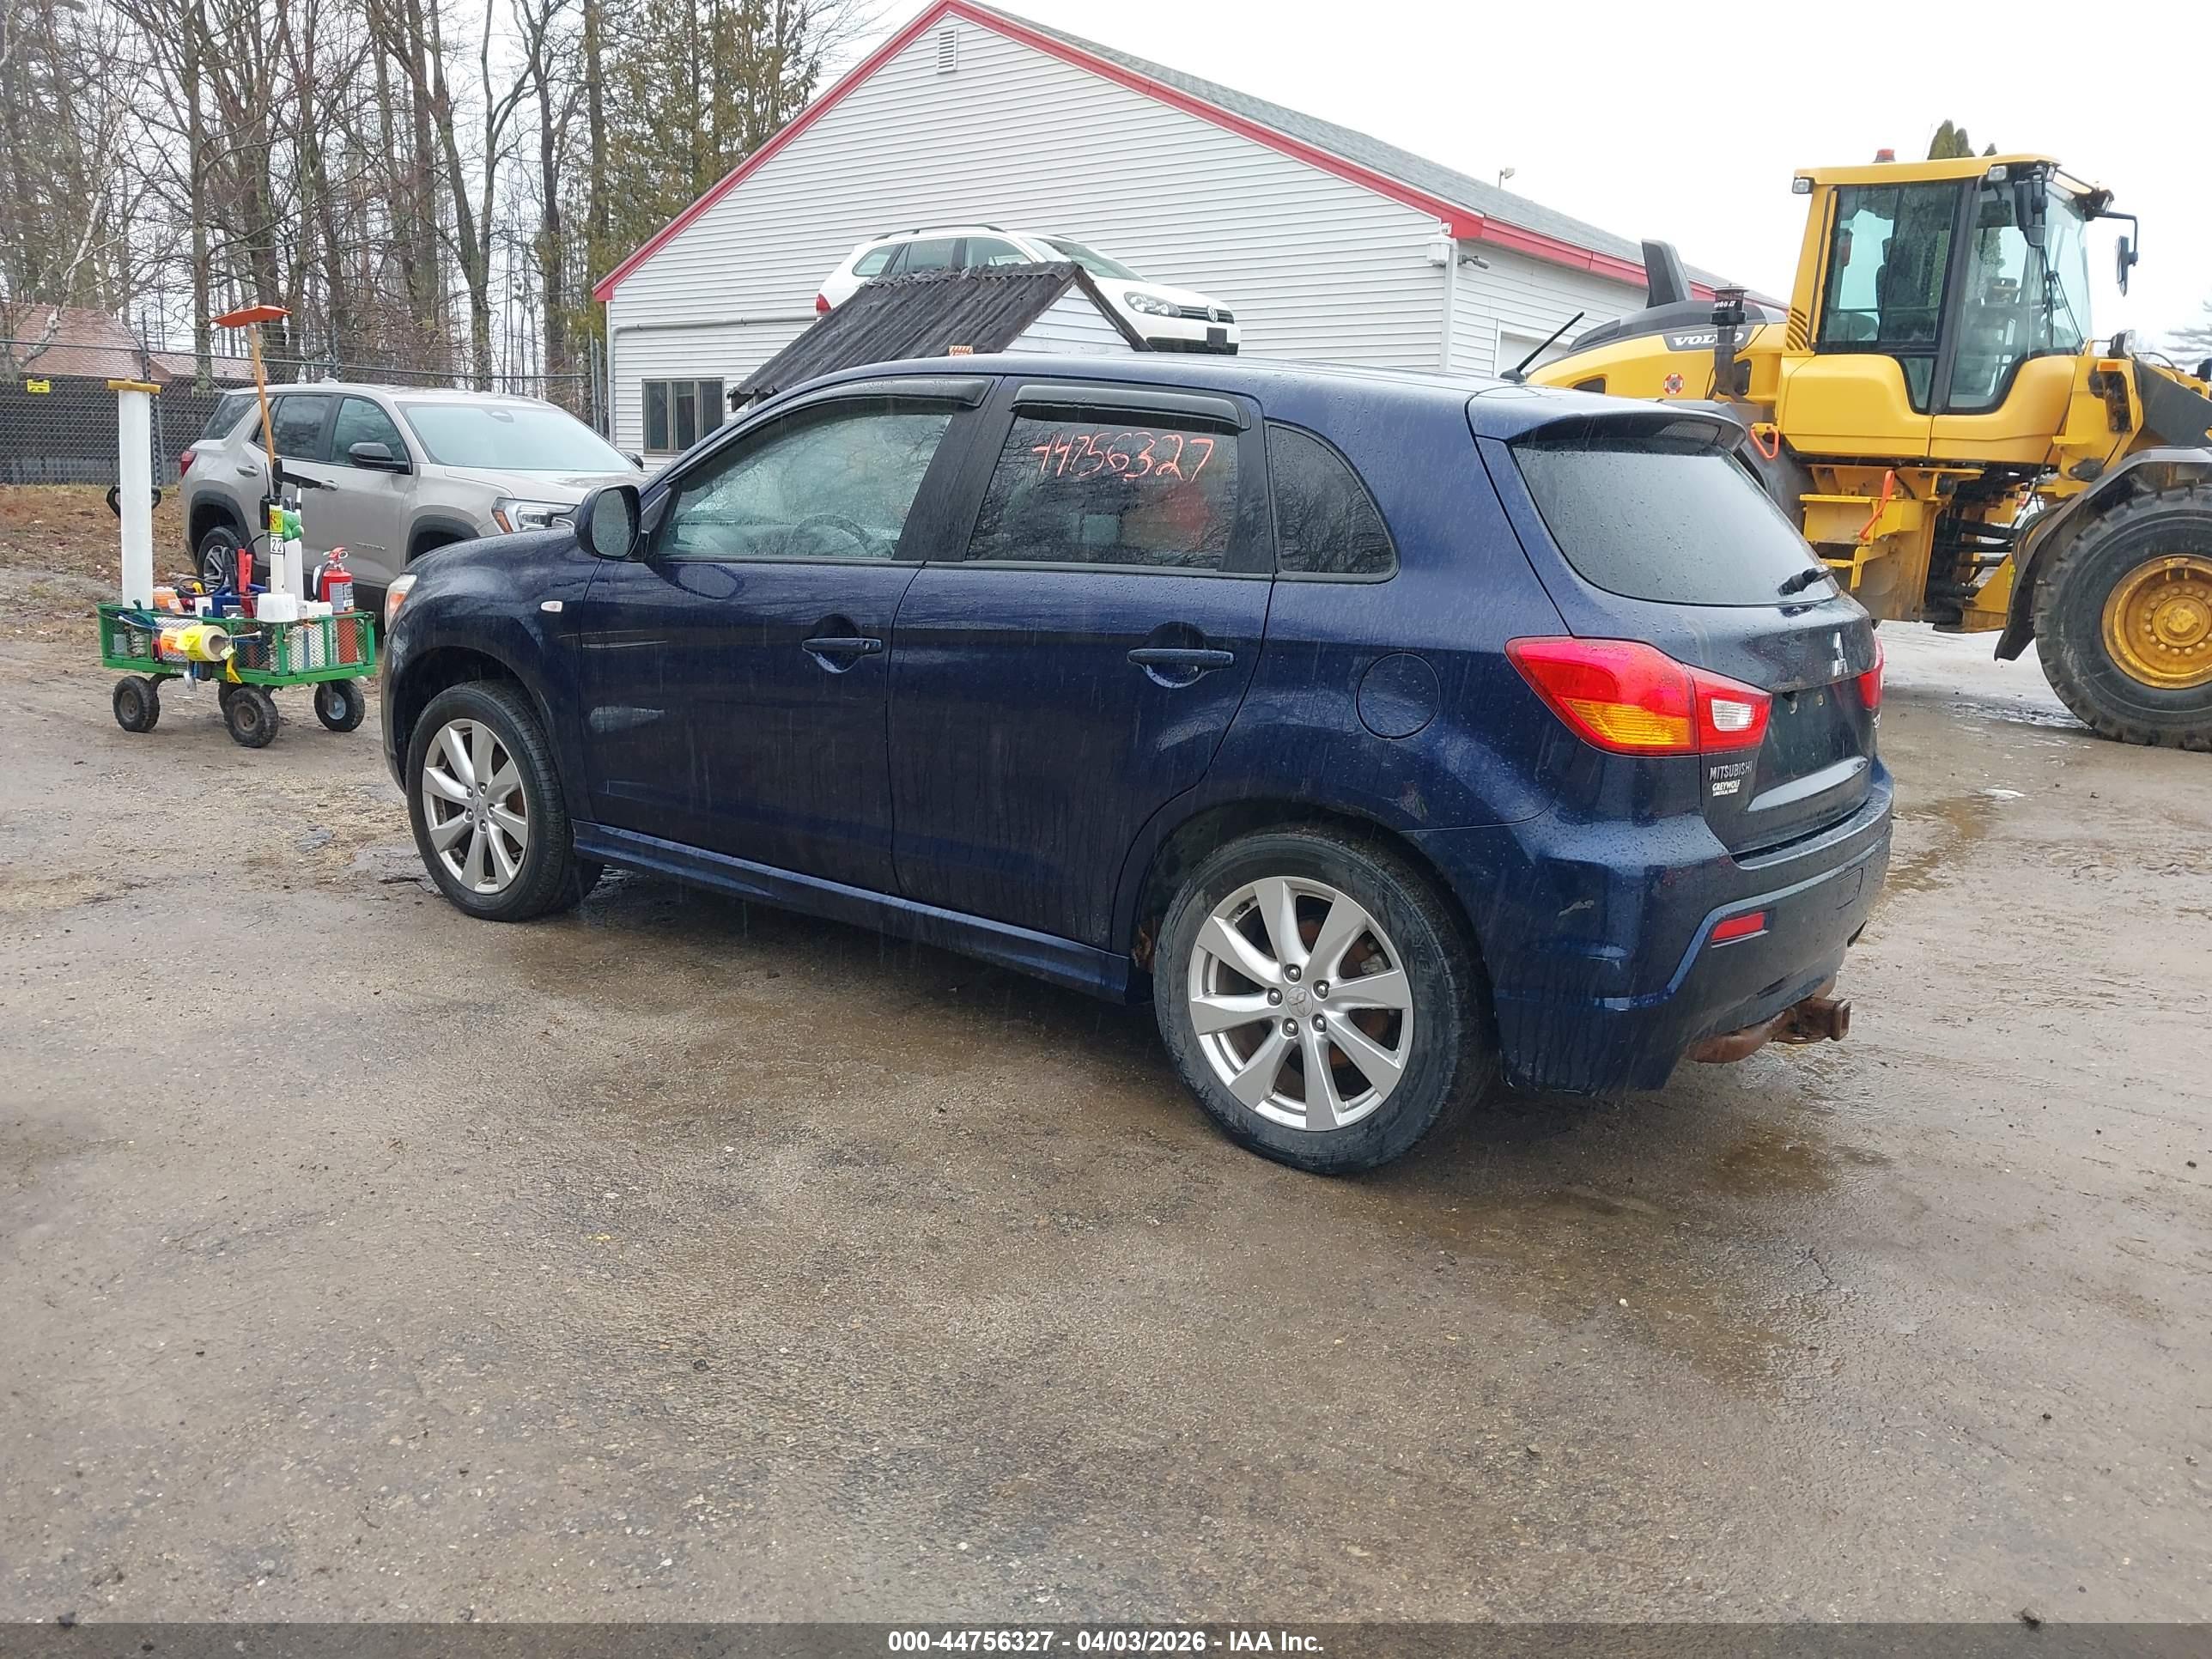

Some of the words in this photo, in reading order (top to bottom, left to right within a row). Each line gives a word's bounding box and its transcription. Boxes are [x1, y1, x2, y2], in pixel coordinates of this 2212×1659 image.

[1673, 332, 1744, 346] VOLO
[271, 538, 283, 552] 22
[1710, 761, 1753, 781] MITSUBISHI
